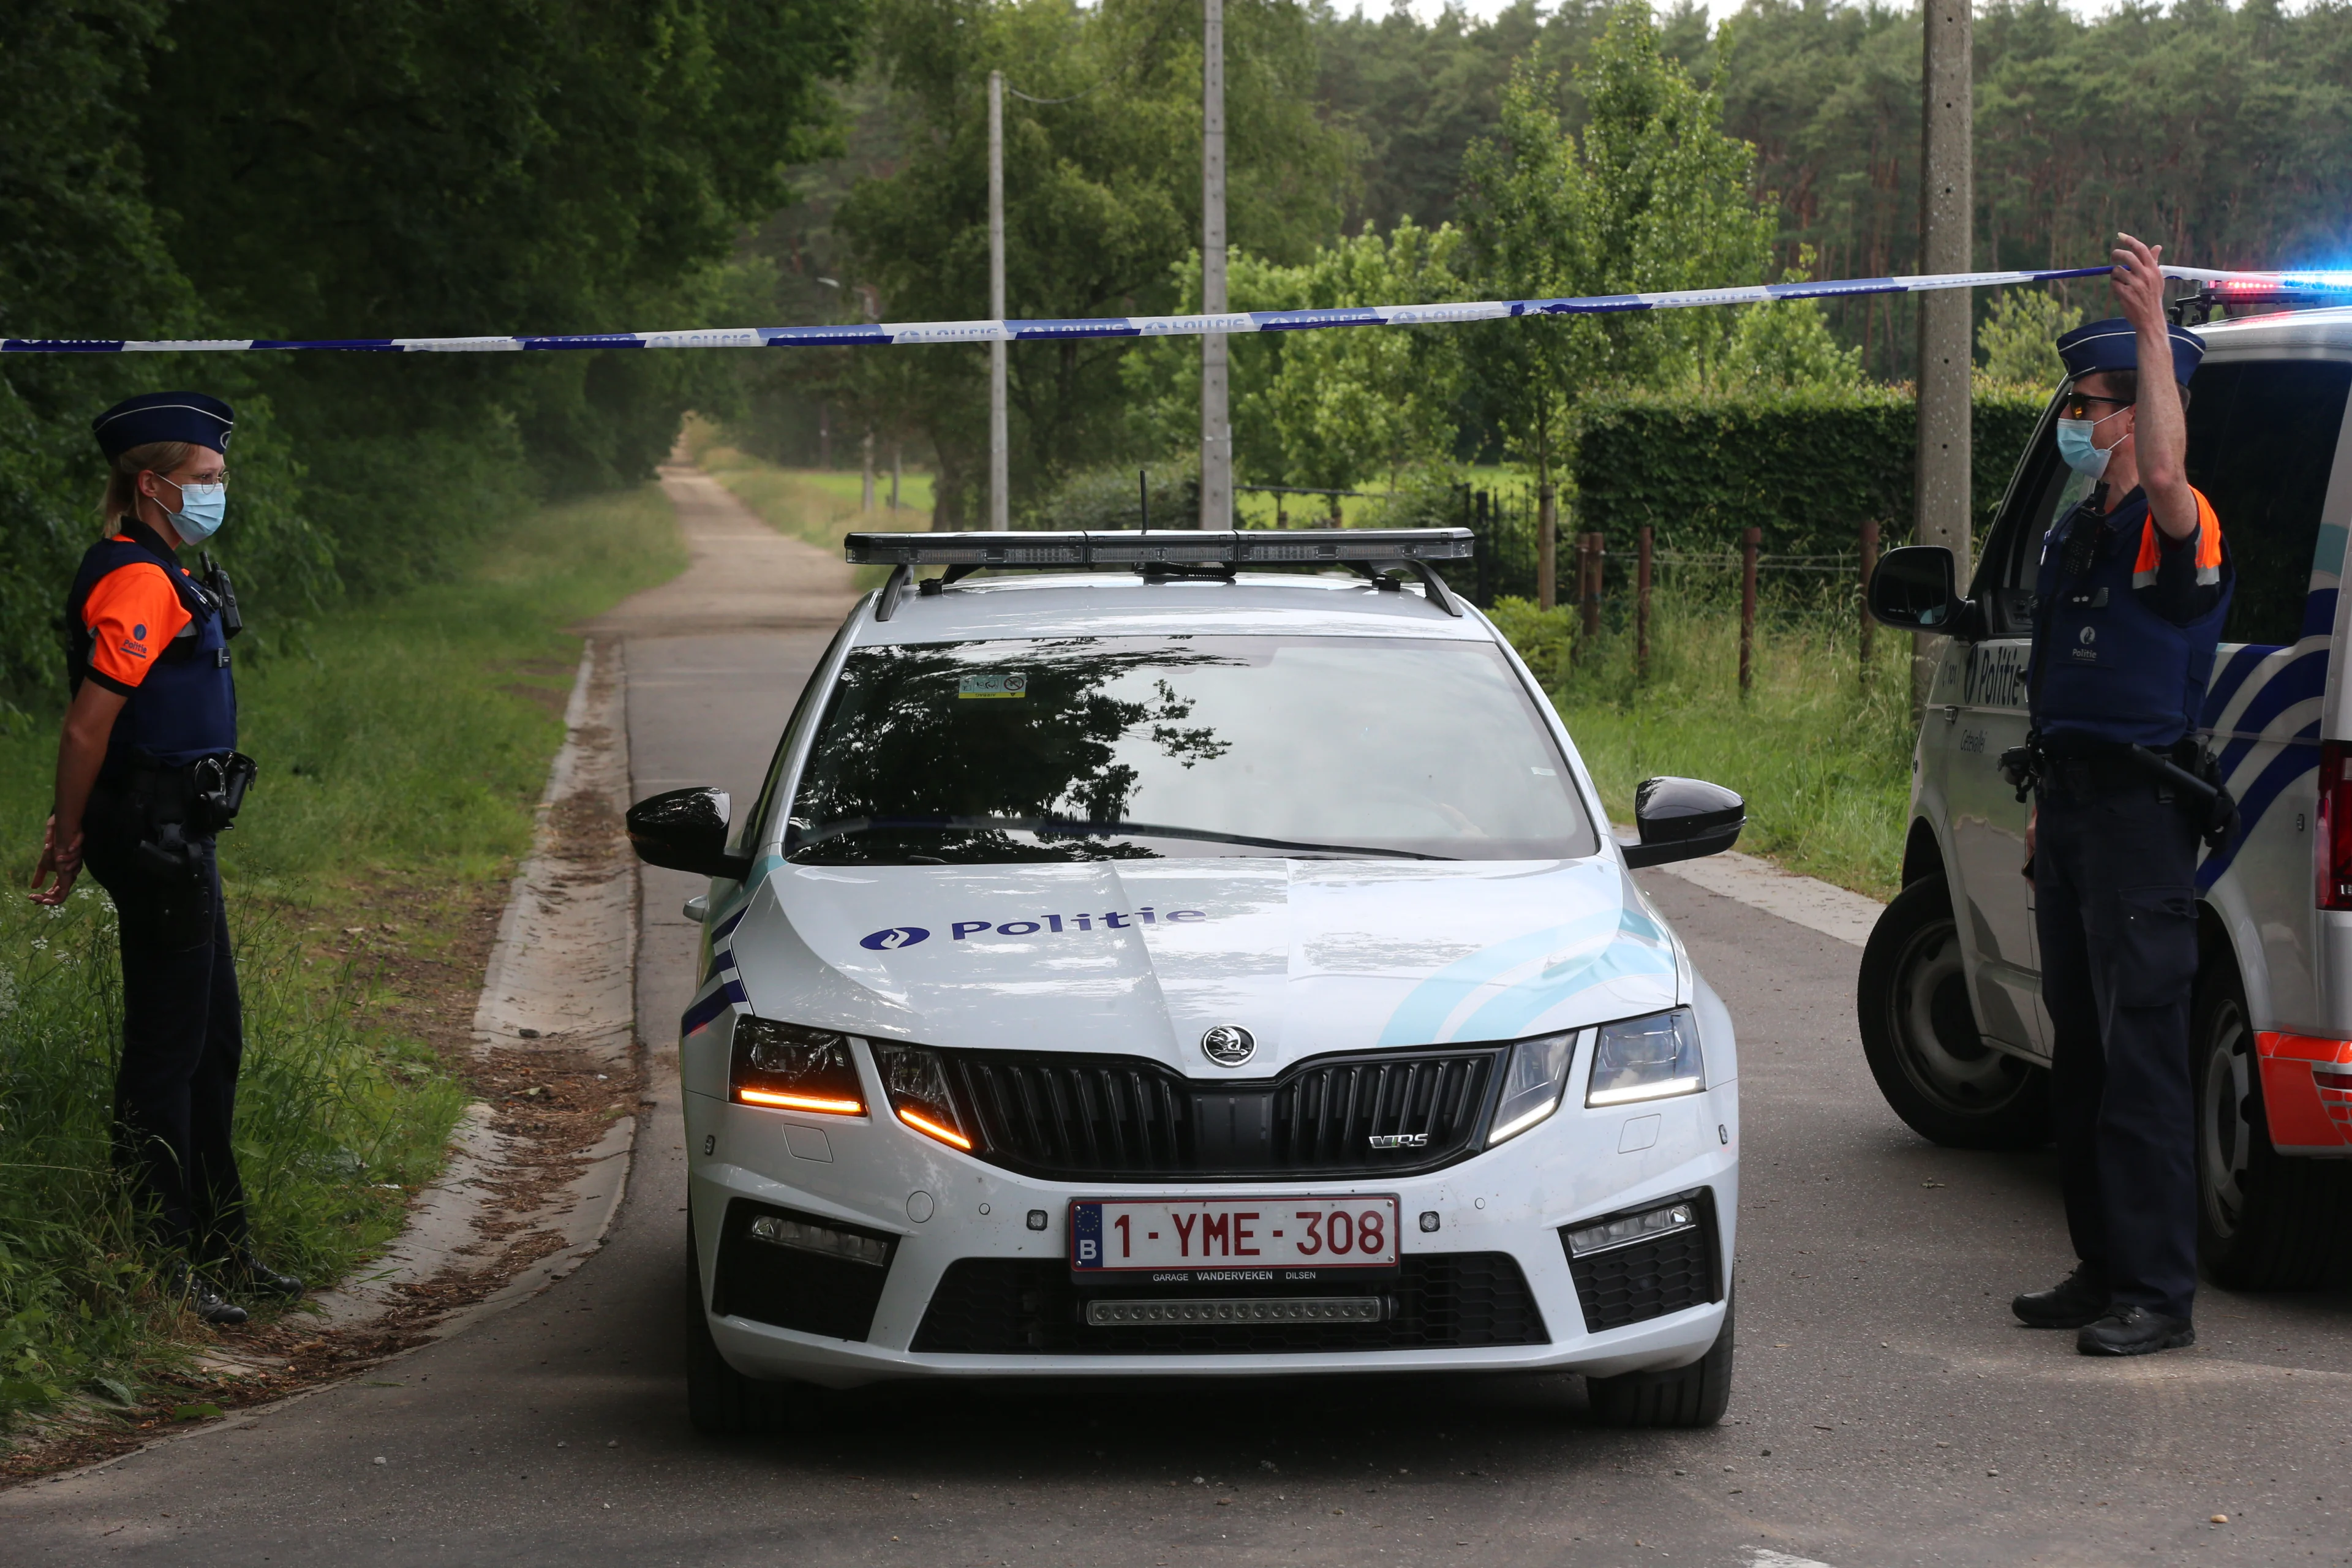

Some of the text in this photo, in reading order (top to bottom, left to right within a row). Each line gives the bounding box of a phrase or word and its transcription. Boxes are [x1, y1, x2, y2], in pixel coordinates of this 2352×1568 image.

[123, 639, 147, 654] Politie
[2072, 648, 2097, 658] Politie
[1977, 646, 2021, 706] Politie
[951, 907, 1207, 940] Politie
[1114, 1210, 1384, 1258] 1-YME-308
[1080, 1239, 1097, 1260] B
[1153, 1271, 1316, 1282] GARAGE VANDERVEKEN DILSEN
